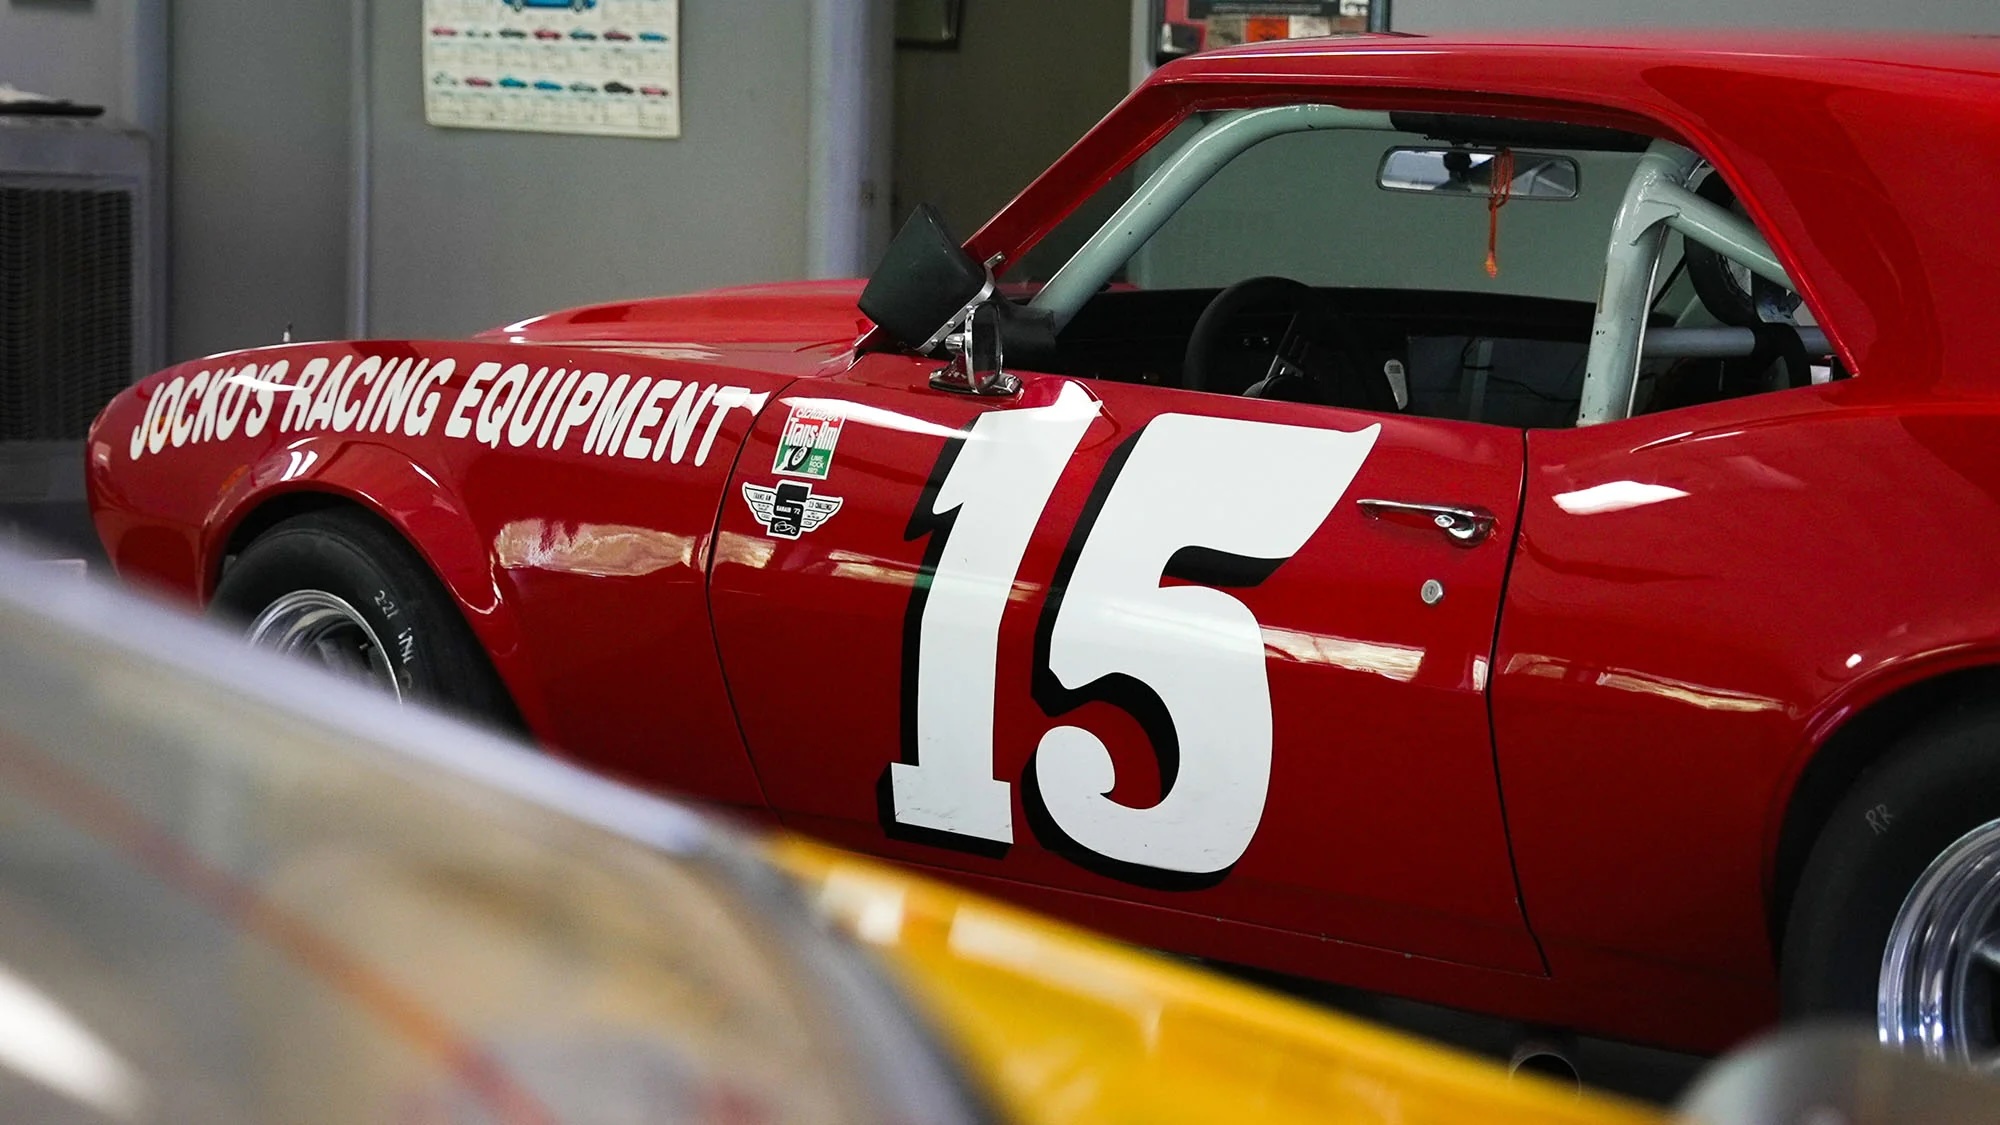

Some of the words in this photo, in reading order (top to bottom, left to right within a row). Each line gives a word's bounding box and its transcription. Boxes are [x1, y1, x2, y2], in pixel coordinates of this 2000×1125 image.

[130, 359, 290, 461] JOCKO'S
[280, 355, 456, 437] RACING
[444, 362, 752, 467] EQUIPMENT
[877, 400, 1382, 892] 15
[1861, 800, 1885, 826] RR
